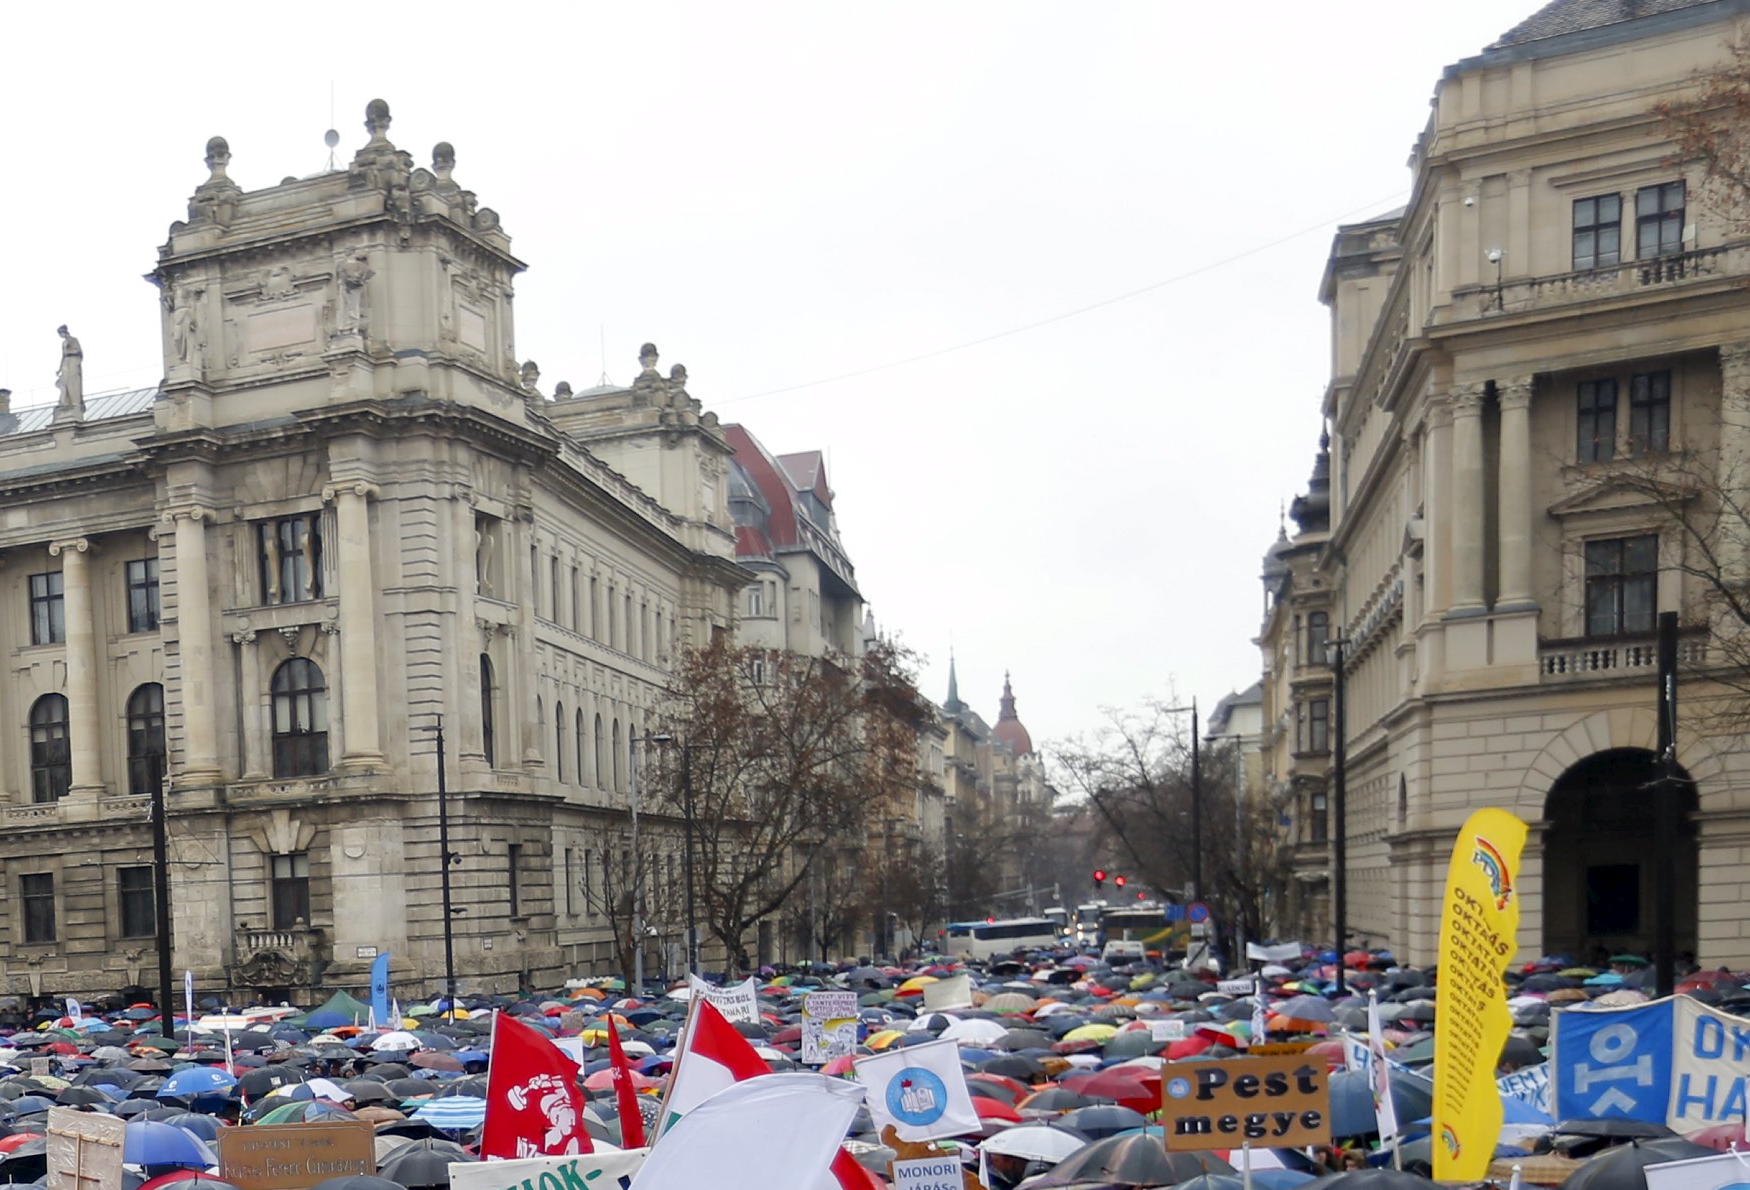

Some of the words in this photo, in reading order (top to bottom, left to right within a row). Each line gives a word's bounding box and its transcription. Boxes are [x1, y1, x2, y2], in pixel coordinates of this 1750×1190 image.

[1194, 1064, 1319, 1101] Pest
[1174, 1110, 1322, 1138] megye
[898, 1164, 957, 1179] MONORI
